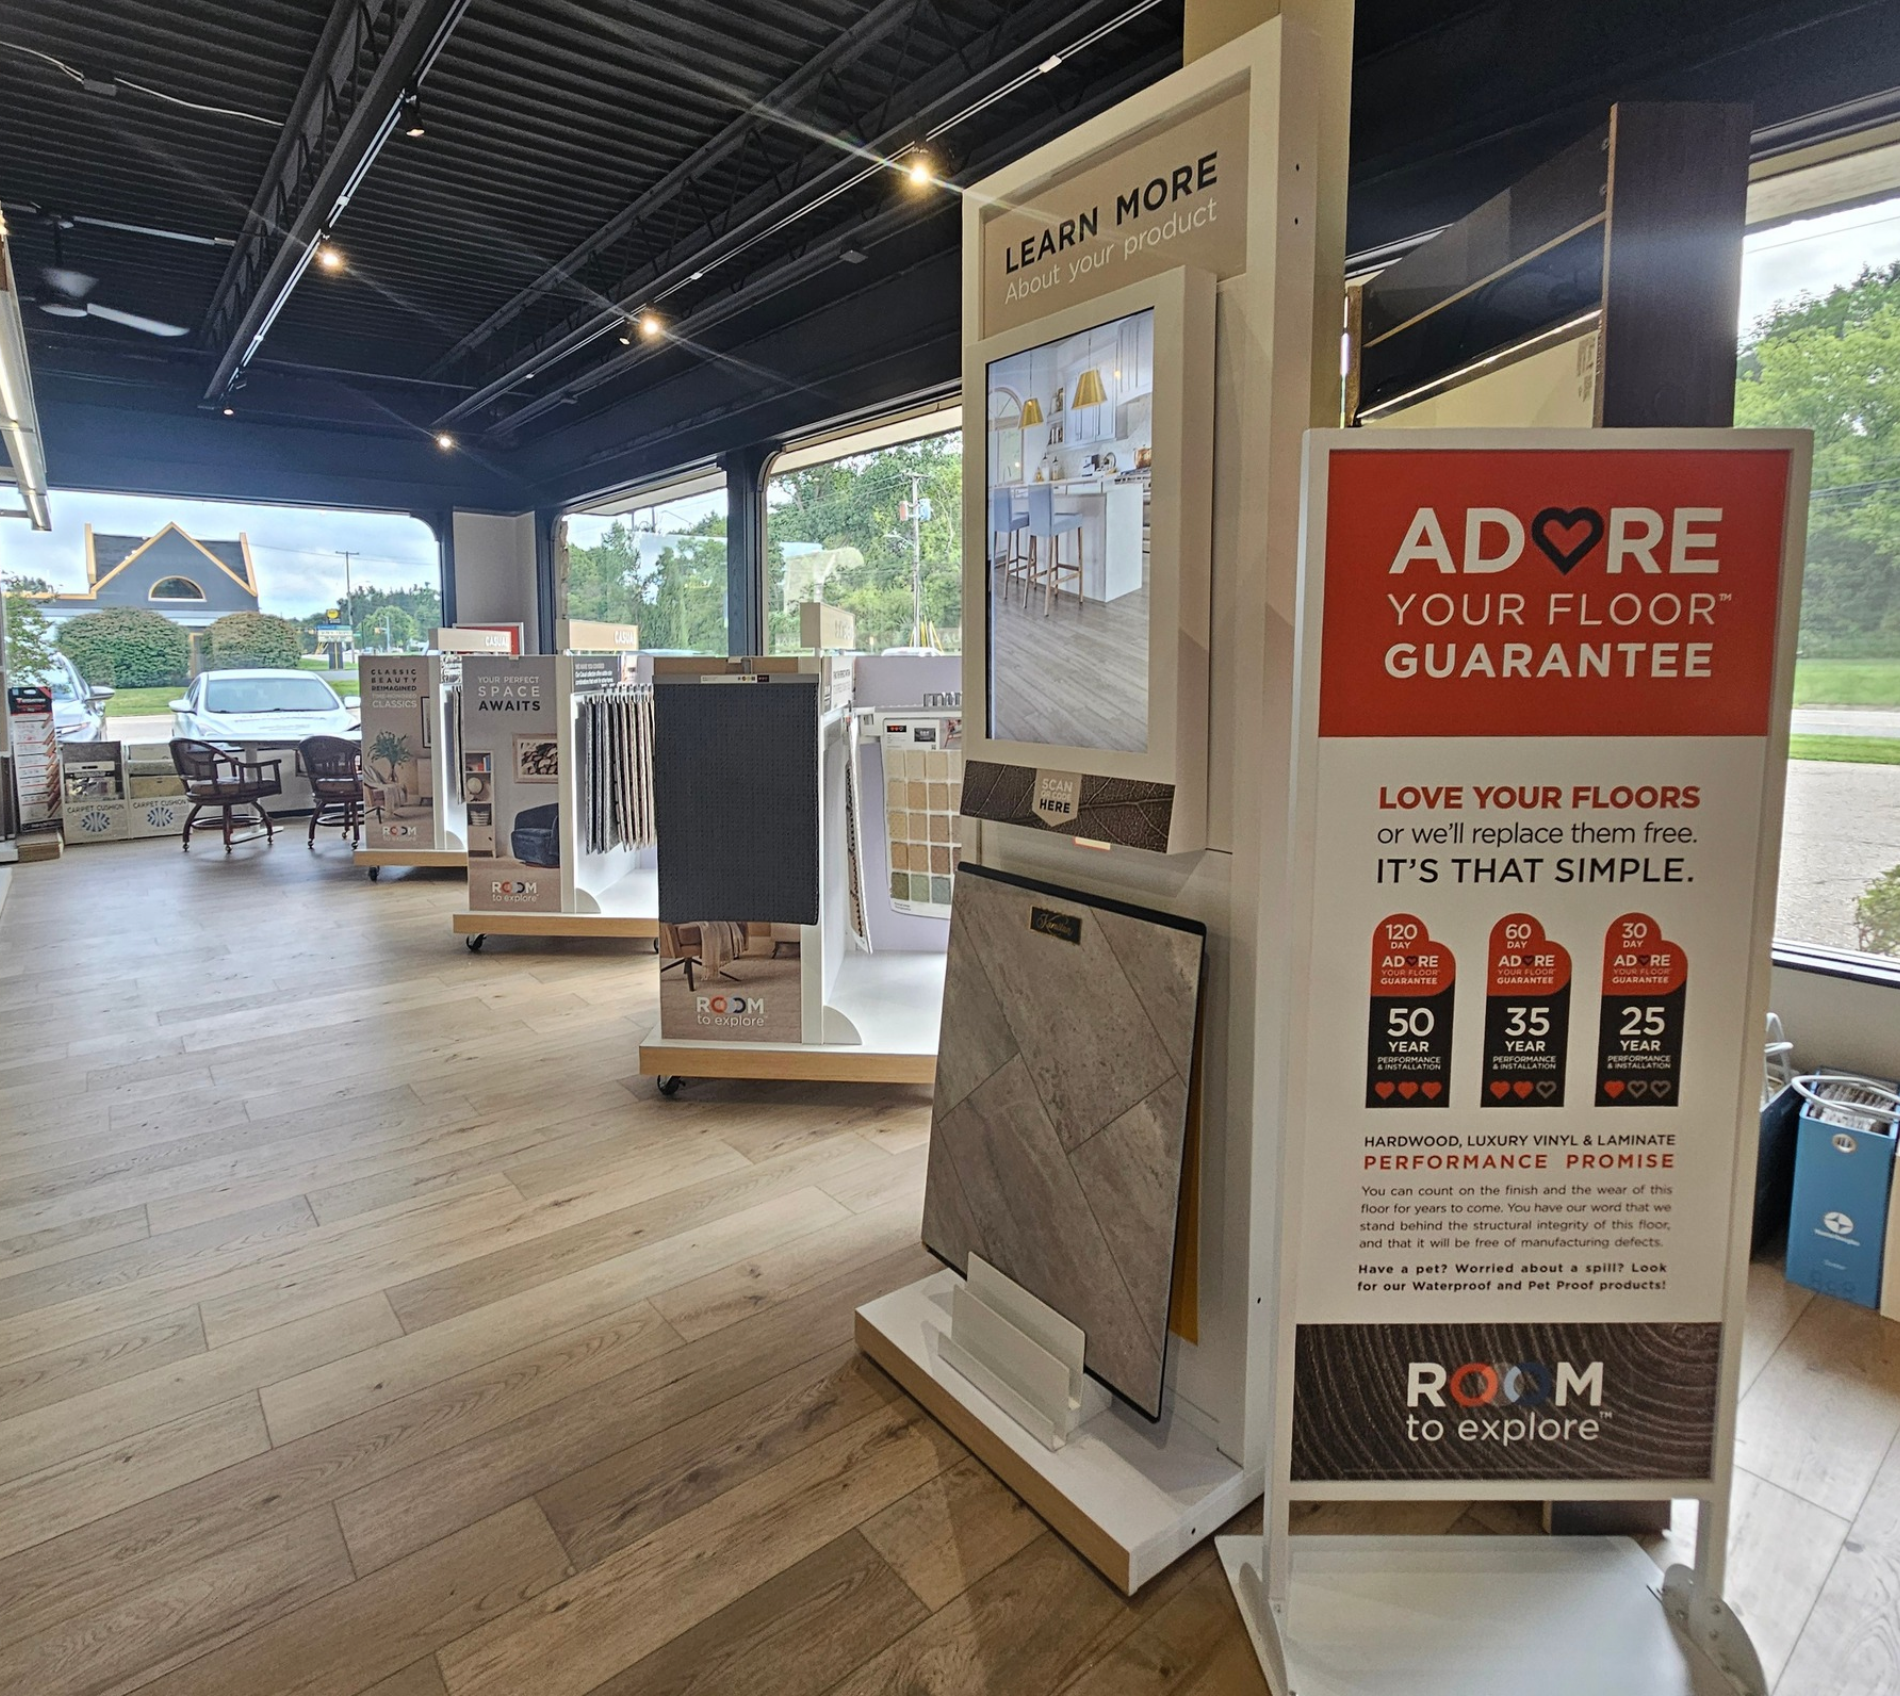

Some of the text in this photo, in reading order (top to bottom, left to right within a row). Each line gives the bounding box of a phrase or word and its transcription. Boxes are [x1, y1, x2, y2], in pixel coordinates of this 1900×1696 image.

[1005, 150, 1218, 275] LEARN MORE
[1004, 196, 1218, 305] About your product
[1386, 593, 1524, 626] YOUR
[1384, 642, 1713, 679] GUARANTEE
[478, 676, 540, 684] YOUR PERFECT
[478, 685, 540, 697] SPACE
[372, 700, 417, 708] CLASSICS
[478, 700, 541, 711] AWAITS
[1041, 778, 1073, 792] SCAN
[1379, 785, 1701, 809] LOVE YOUR FLOORS
[67, 803, 124, 814] CARPET CUSHION
[133, 800, 158, 809] CARPET
[1039, 798, 1071, 814] HERE
[1377, 821, 1698, 848] or we'll replace them free.
[1377, 857, 1694, 884] IT'S THAT SIMPLE.
[492, 881, 537, 894] ROOM
[1385, 923, 1418, 940] 120
[1505, 923, 1531, 940] 60
[1621, 923, 1647, 939] 30
[1390, 941, 1411, 950] DAY
[1507, 941, 1528, 949] DAY
[1623, 940, 1644, 948] DAY
[1498, 968, 1521, 976] YOUR
[1380, 977, 1438, 985] GUARANTEE
[1497, 976, 1554, 984] GUARANTEE
[1612, 976, 1669, 984] GUARANTEE
[696, 996, 764, 1014] ROOM
[697, 1014, 711, 1025] to
[1387, 1007, 1435, 1037] 50
[1504, 1007, 1550, 1036] 35
[1619, 1006, 1665, 1036] 25
[1388, 1041, 1429, 1053] YEAR
[1505, 1040, 1546, 1052] YEAR
[1620, 1040, 1661, 1051] YEAR
[1377, 1056, 1441, 1064] PERFORMANCE
[1492, 1055, 1556, 1063] PERFORMANCE
[1364, 1134, 1676, 1148] HARDWOOD, LUXURY VINYL & LAMINATE
[1363, 1153, 1675, 1170] PERFORMANCE PROMISE
[1361, 1184, 1673, 1197] You can count on the finish and the wear of this
[1360, 1202, 1672, 1216] floor for years to come. You have our word that we
[1359, 1219, 1671, 1232] stand behind the structural integrity of this floor,
[1359, 1236, 1663, 1249] and that it will be free of manufacturing defects.
[1358, 1262, 1667, 1276] Have a pet? Worried about a spill? Look
[1357, 1279, 1666, 1293] for our Waterproof and Pet Proof products!
[1407, 1361, 1604, 1407] ROOM
[1406, 1413, 1444, 1441] to
